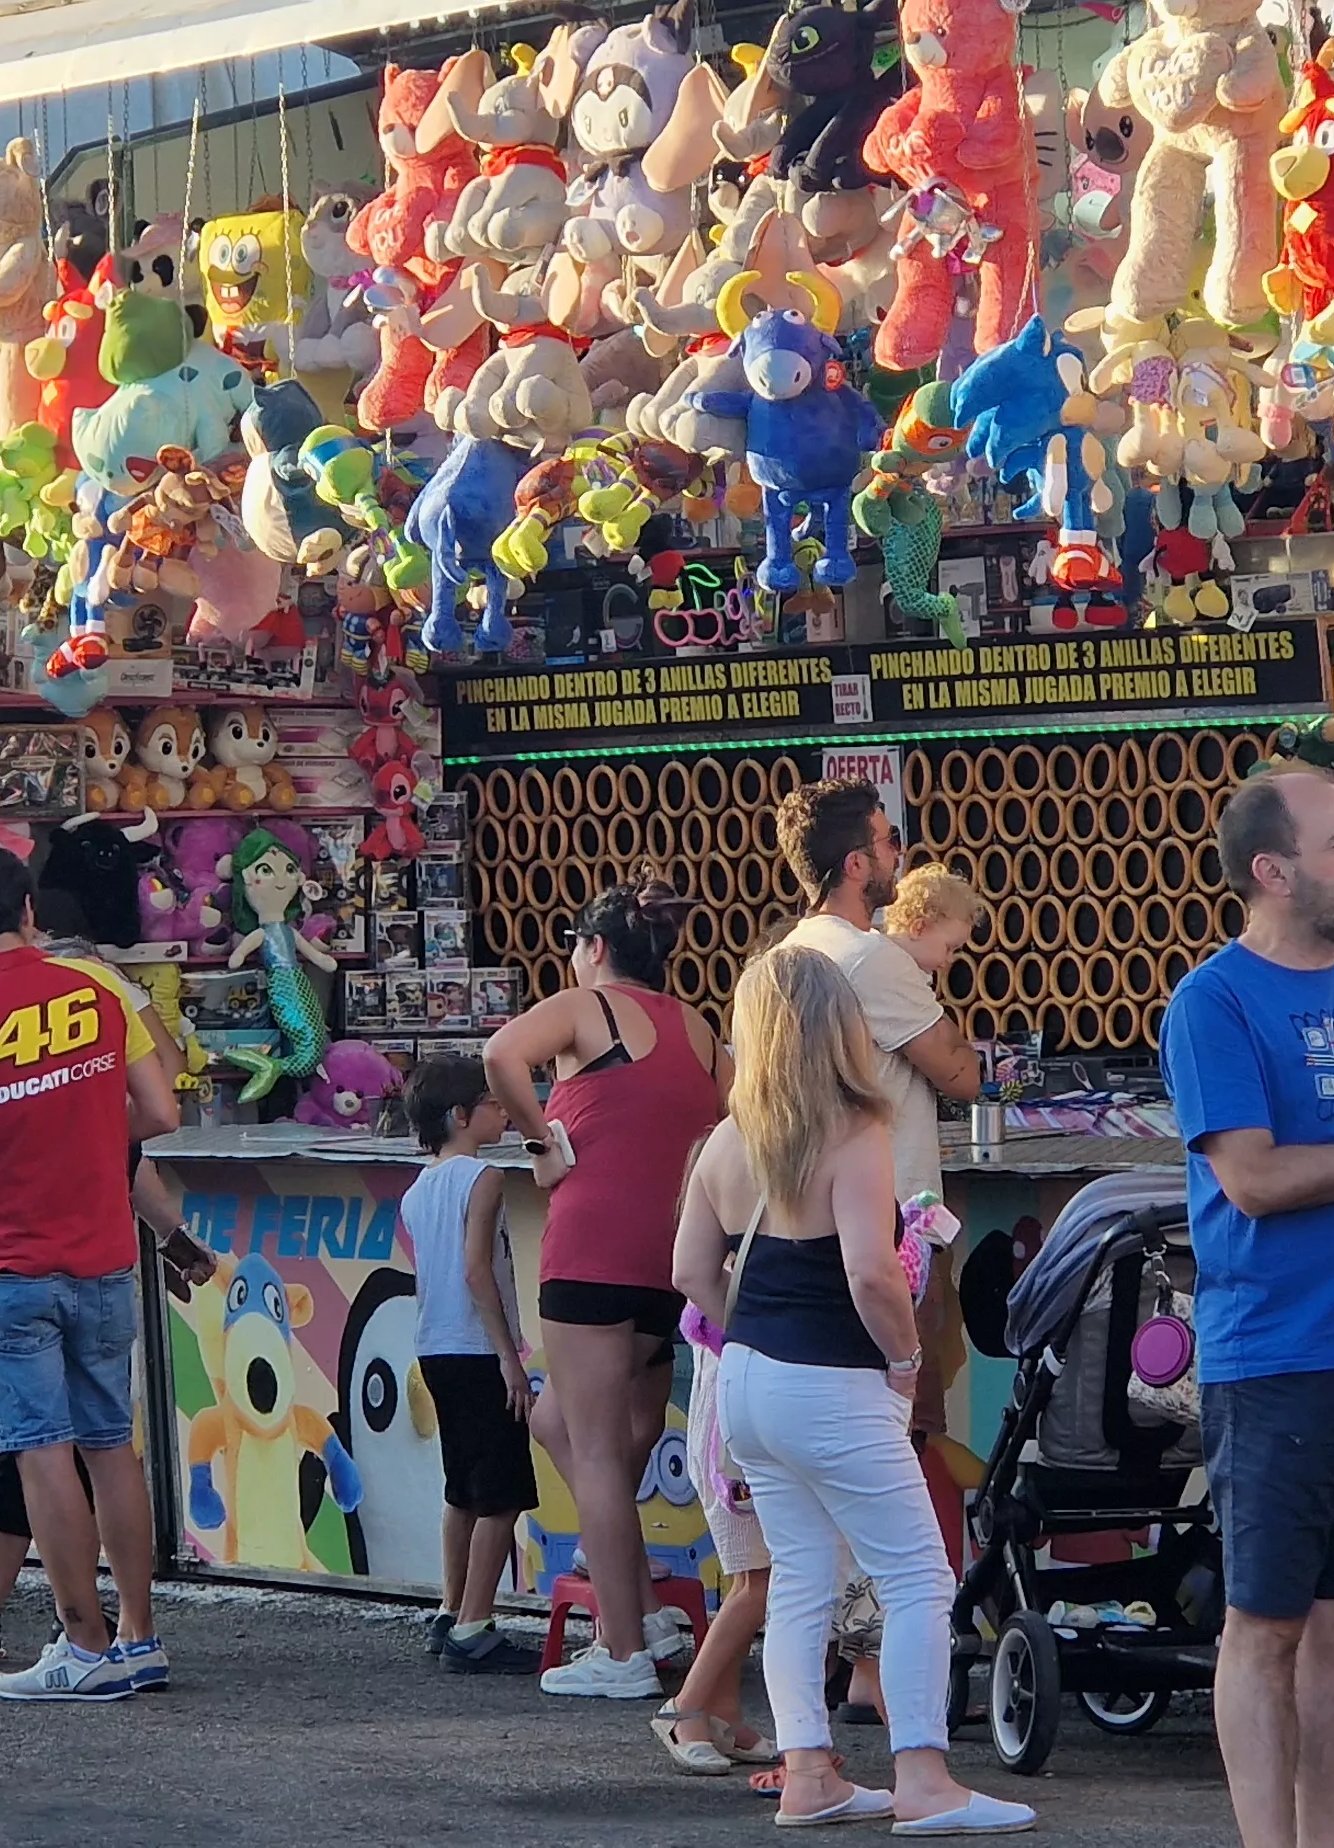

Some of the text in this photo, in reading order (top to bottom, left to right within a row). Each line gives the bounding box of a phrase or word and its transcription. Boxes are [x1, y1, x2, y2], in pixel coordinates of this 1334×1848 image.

[870, 630, 1295, 680] PINCHANDO DENTRO DE 3 ANILLAS DIFERENTES
[456, 657, 833, 705] PINCHANDO DENTRO DE 3 ANILLAS DIFERENTES
[834, 682, 859, 697] TIRAR
[902, 666, 1257, 711] EN LA MISMA JUGADA PREMIO A ELEGIR
[487, 690, 800, 733] EN LA MISMA JUGADA PREMIO A ELEGIR
[835, 701, 861, 717] RECTO
[827, 754, 894, 785] OFERTA
[70, 1052, 117, 1082] CORSE
[248, 1194, 398, 1261] FERIA
